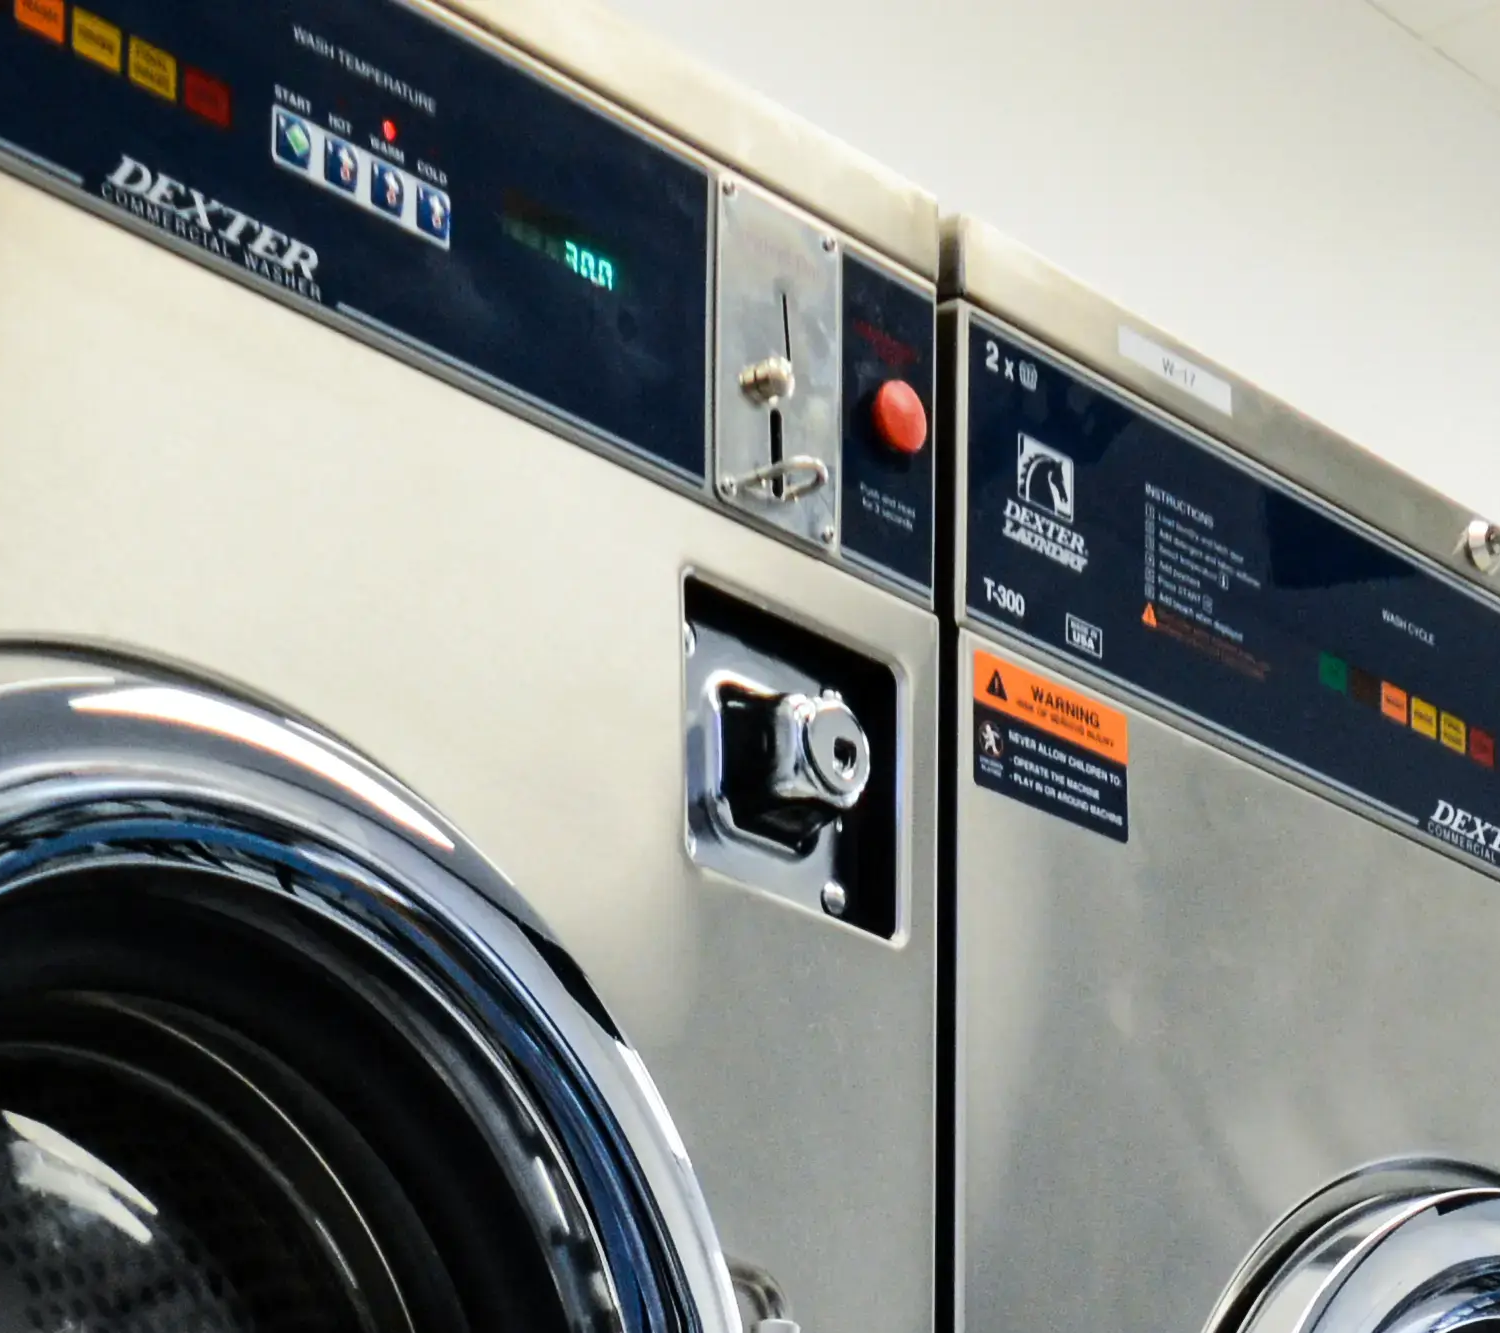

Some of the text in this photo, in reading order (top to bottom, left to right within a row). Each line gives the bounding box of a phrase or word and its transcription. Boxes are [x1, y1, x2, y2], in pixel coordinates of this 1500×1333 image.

[293, 23, 436, 116] WASH TEMPERATURE
[274, 84, 448, 187] START HOT WARM COLD
[101, 182, 323, 302] COMMERCIAL WASHER
[106, 153, 319, 281] DEXTER
[985, 340, 999, 374] 2
[1003, 498, 1085, 555] DEXTER
[1145, 482, 1214, 530] INSTRUCTIONS
[1002, 520, 1089, 574] LAUNDRY
[983, 577, 1025, 618] T-300
[1382, 608, 1435, 646] WASH CYCLE
[1031, 684, 1100, 729] WARNING
[1008, 729, 1036, 752] NEVER
[1038, 743, 1067, 765] ALLOW
[1067, 756, 1108, 782] CHILDREN
[1013, 755, 1049, 780] OPERATE
[1051, 770, 1065, 785] THE
[1066, 777, 1100, 801] MACHINE
[1013, 772, 1034, 790] PLAY
[1090, 803, 1123, 827] MACHINE
[1427, 820, 1496, 863] COMMERCIAL
